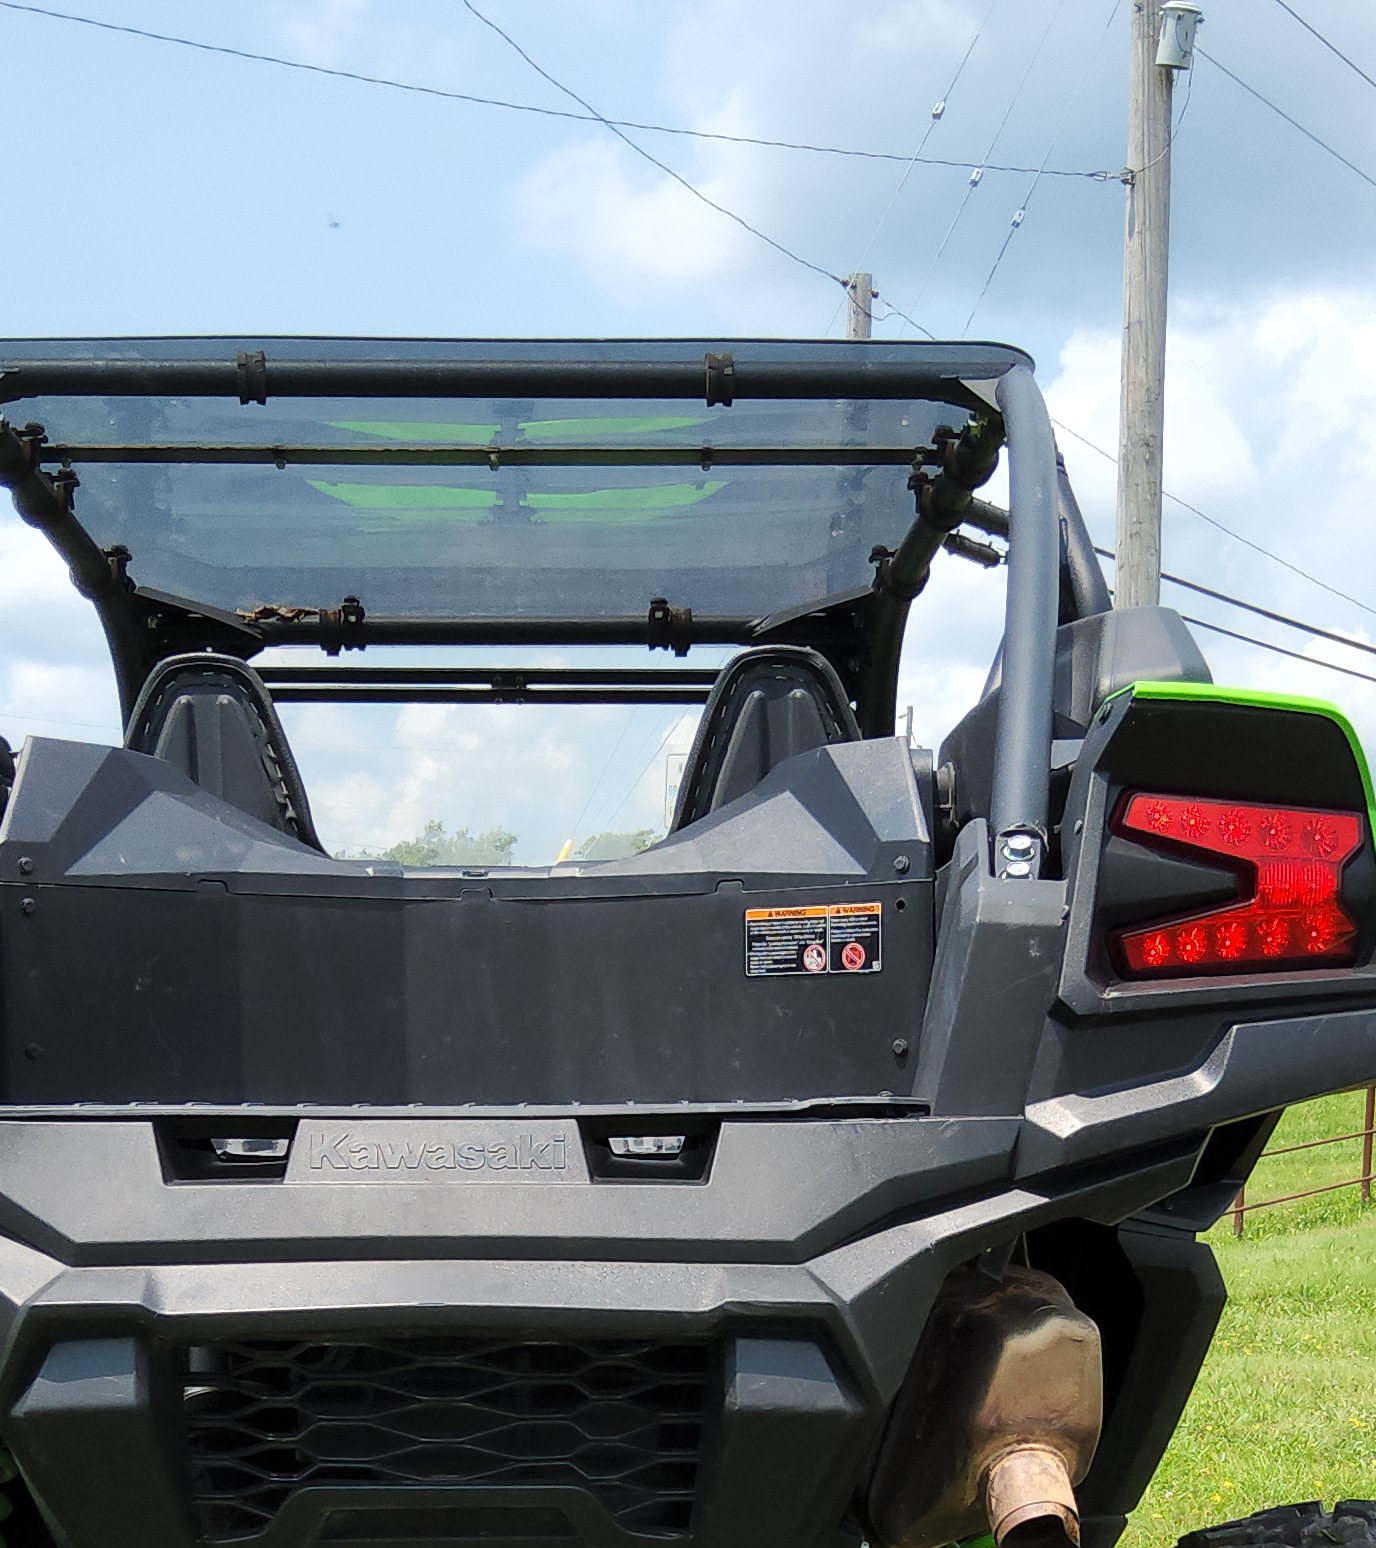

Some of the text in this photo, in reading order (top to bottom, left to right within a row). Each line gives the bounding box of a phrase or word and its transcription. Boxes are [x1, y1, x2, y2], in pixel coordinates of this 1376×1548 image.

[774, 909, 806, 918] WARNING
[843, 905, 875, 914] WARNING
[309, 1133, 568, 1170] Kawasaki
